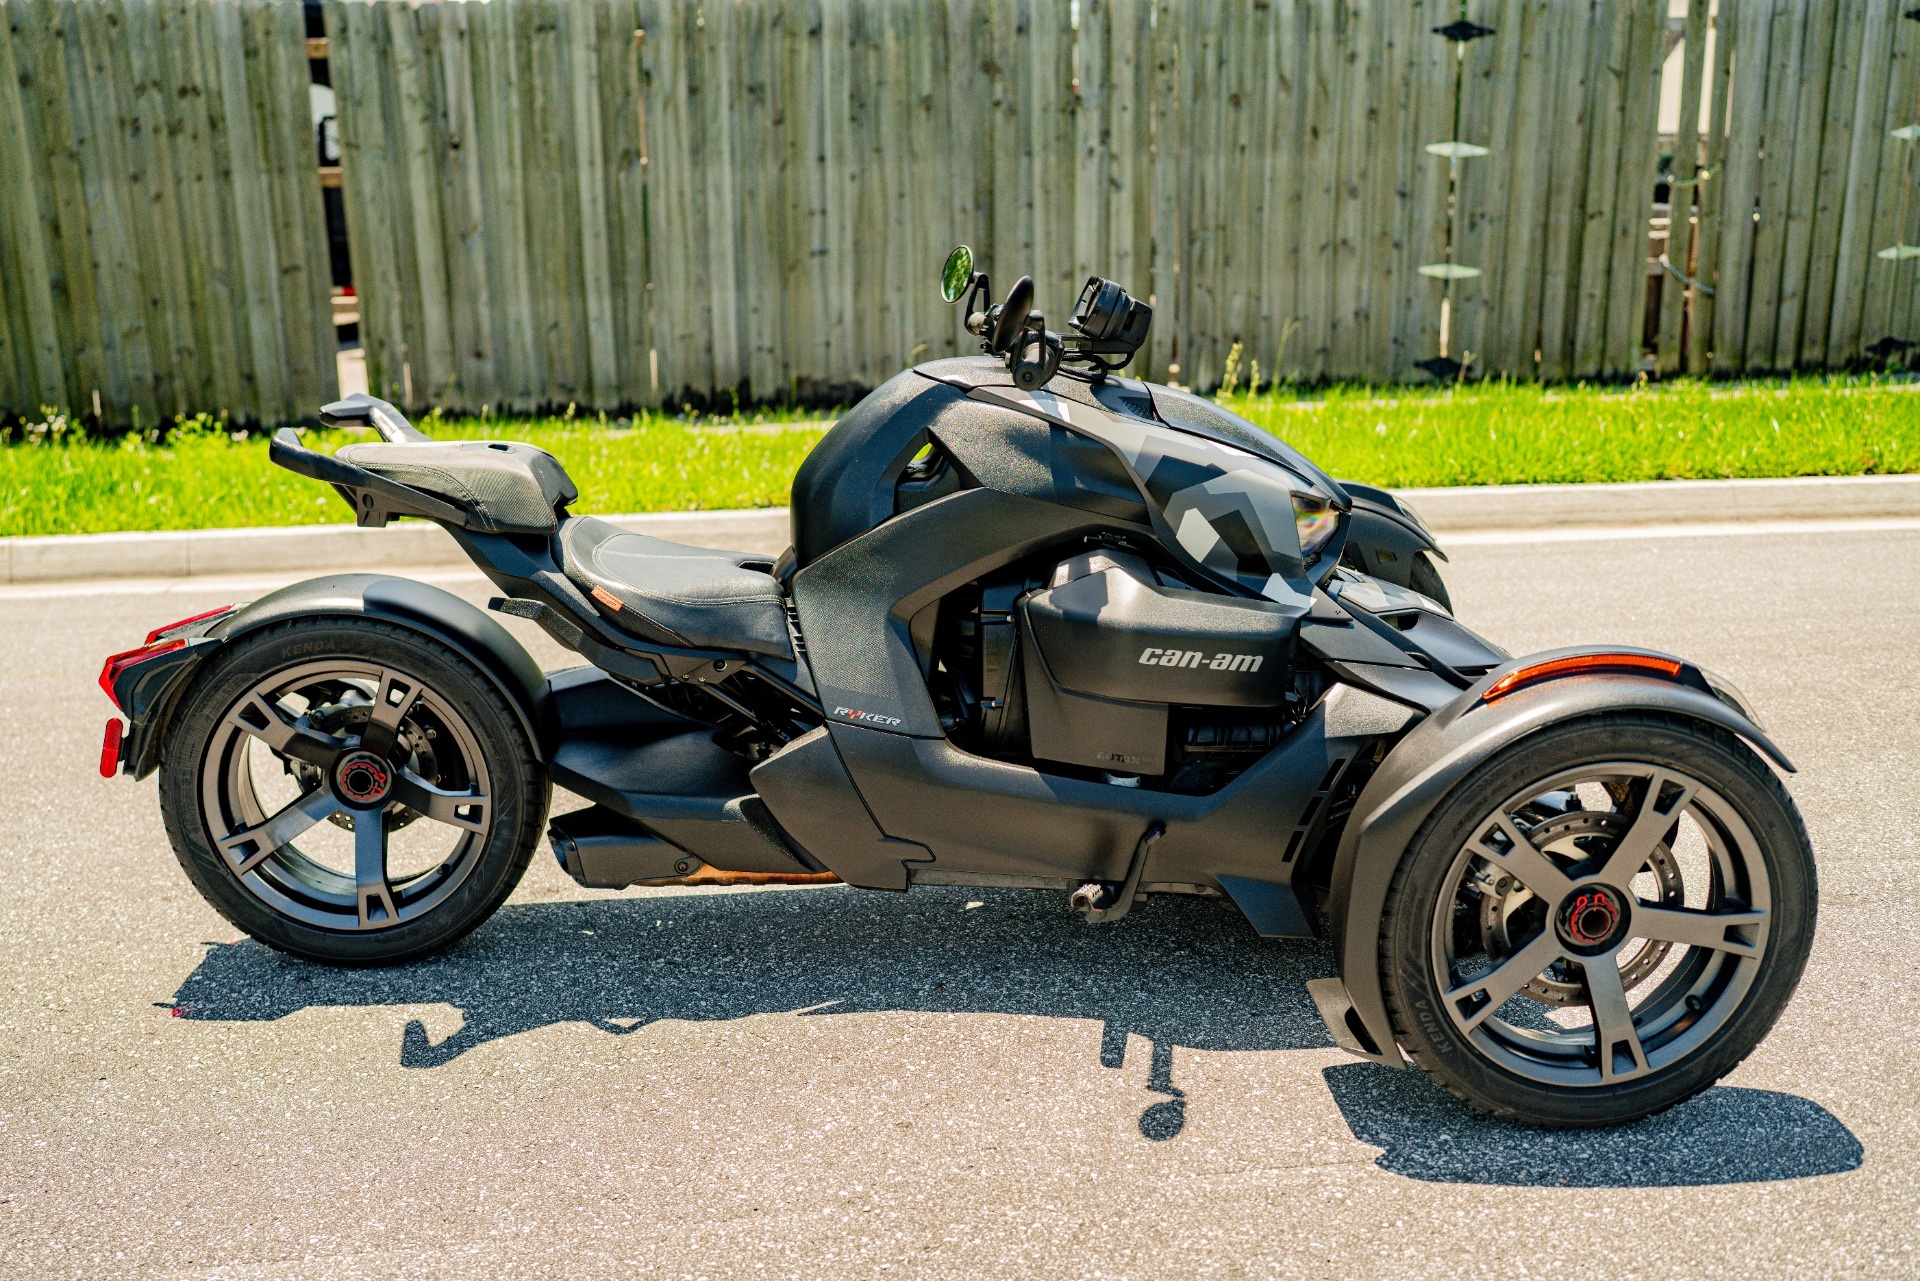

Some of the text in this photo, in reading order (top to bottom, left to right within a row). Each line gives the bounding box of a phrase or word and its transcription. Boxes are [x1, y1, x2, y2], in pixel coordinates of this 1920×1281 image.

[282, 641, 336, 659] KENDA
[1139, 647, 1264, 672] can-am
[833, 706, 902, 726] RYKER
[1415, 1000, 1453, 1053] KENDA
